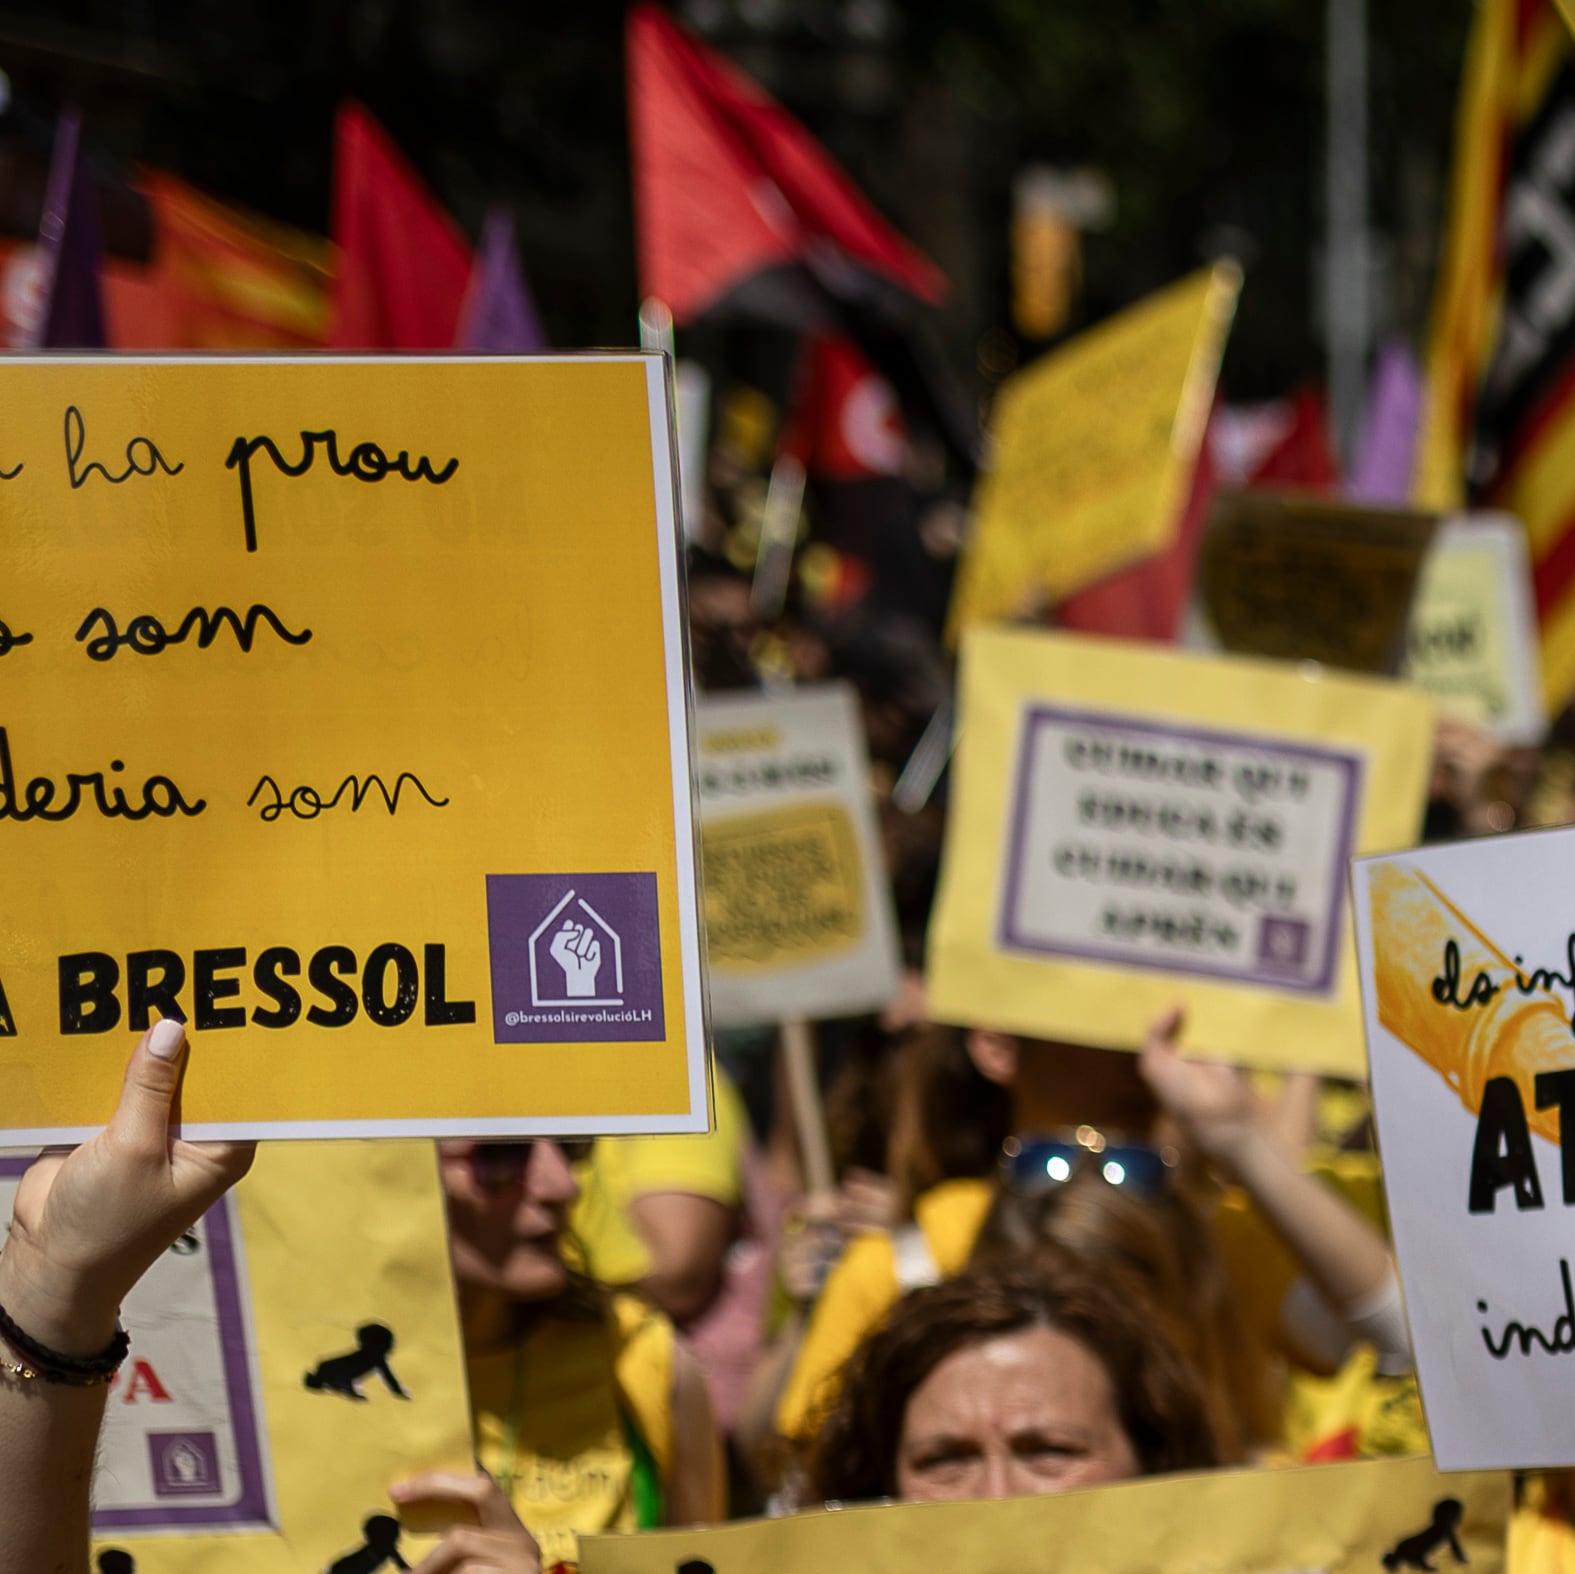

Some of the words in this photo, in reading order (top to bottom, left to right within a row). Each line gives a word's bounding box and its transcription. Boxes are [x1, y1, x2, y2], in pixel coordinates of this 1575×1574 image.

[65, 406, 184, 489] ha
[226, 430, 459, 552] prou
[76, 603, 312, 662] som
[248, 772, 450, 822] som
[58, 942, 476, 1036] BRESSOL
